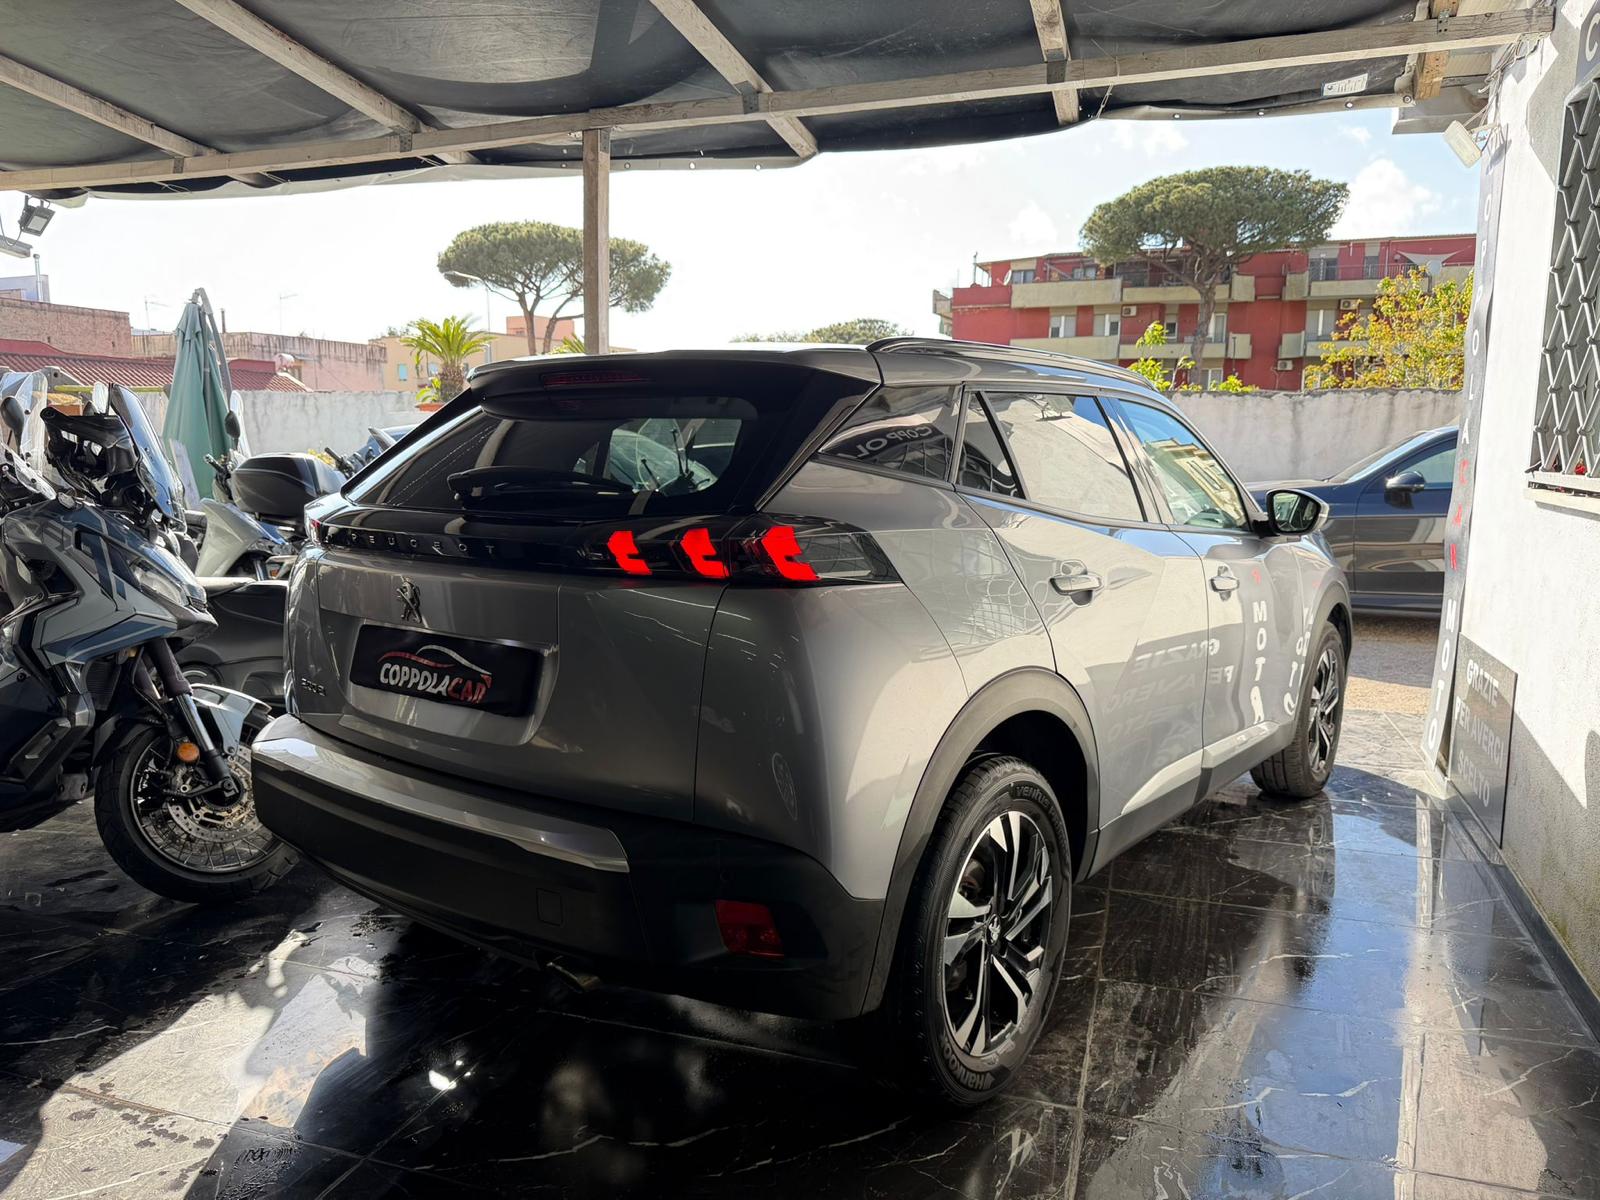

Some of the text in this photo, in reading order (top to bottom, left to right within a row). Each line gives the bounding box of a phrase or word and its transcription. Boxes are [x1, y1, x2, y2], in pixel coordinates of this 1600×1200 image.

[351, 533, 495, 555] PEUGEOT
[1428, 599, 1457, 750] MOTO
[1466, 659, 1500, 708] GRAZIE
[1455, 696, 1505, 766] PER AVERCI
[1457, 748, 1491, 808] SCELTO
